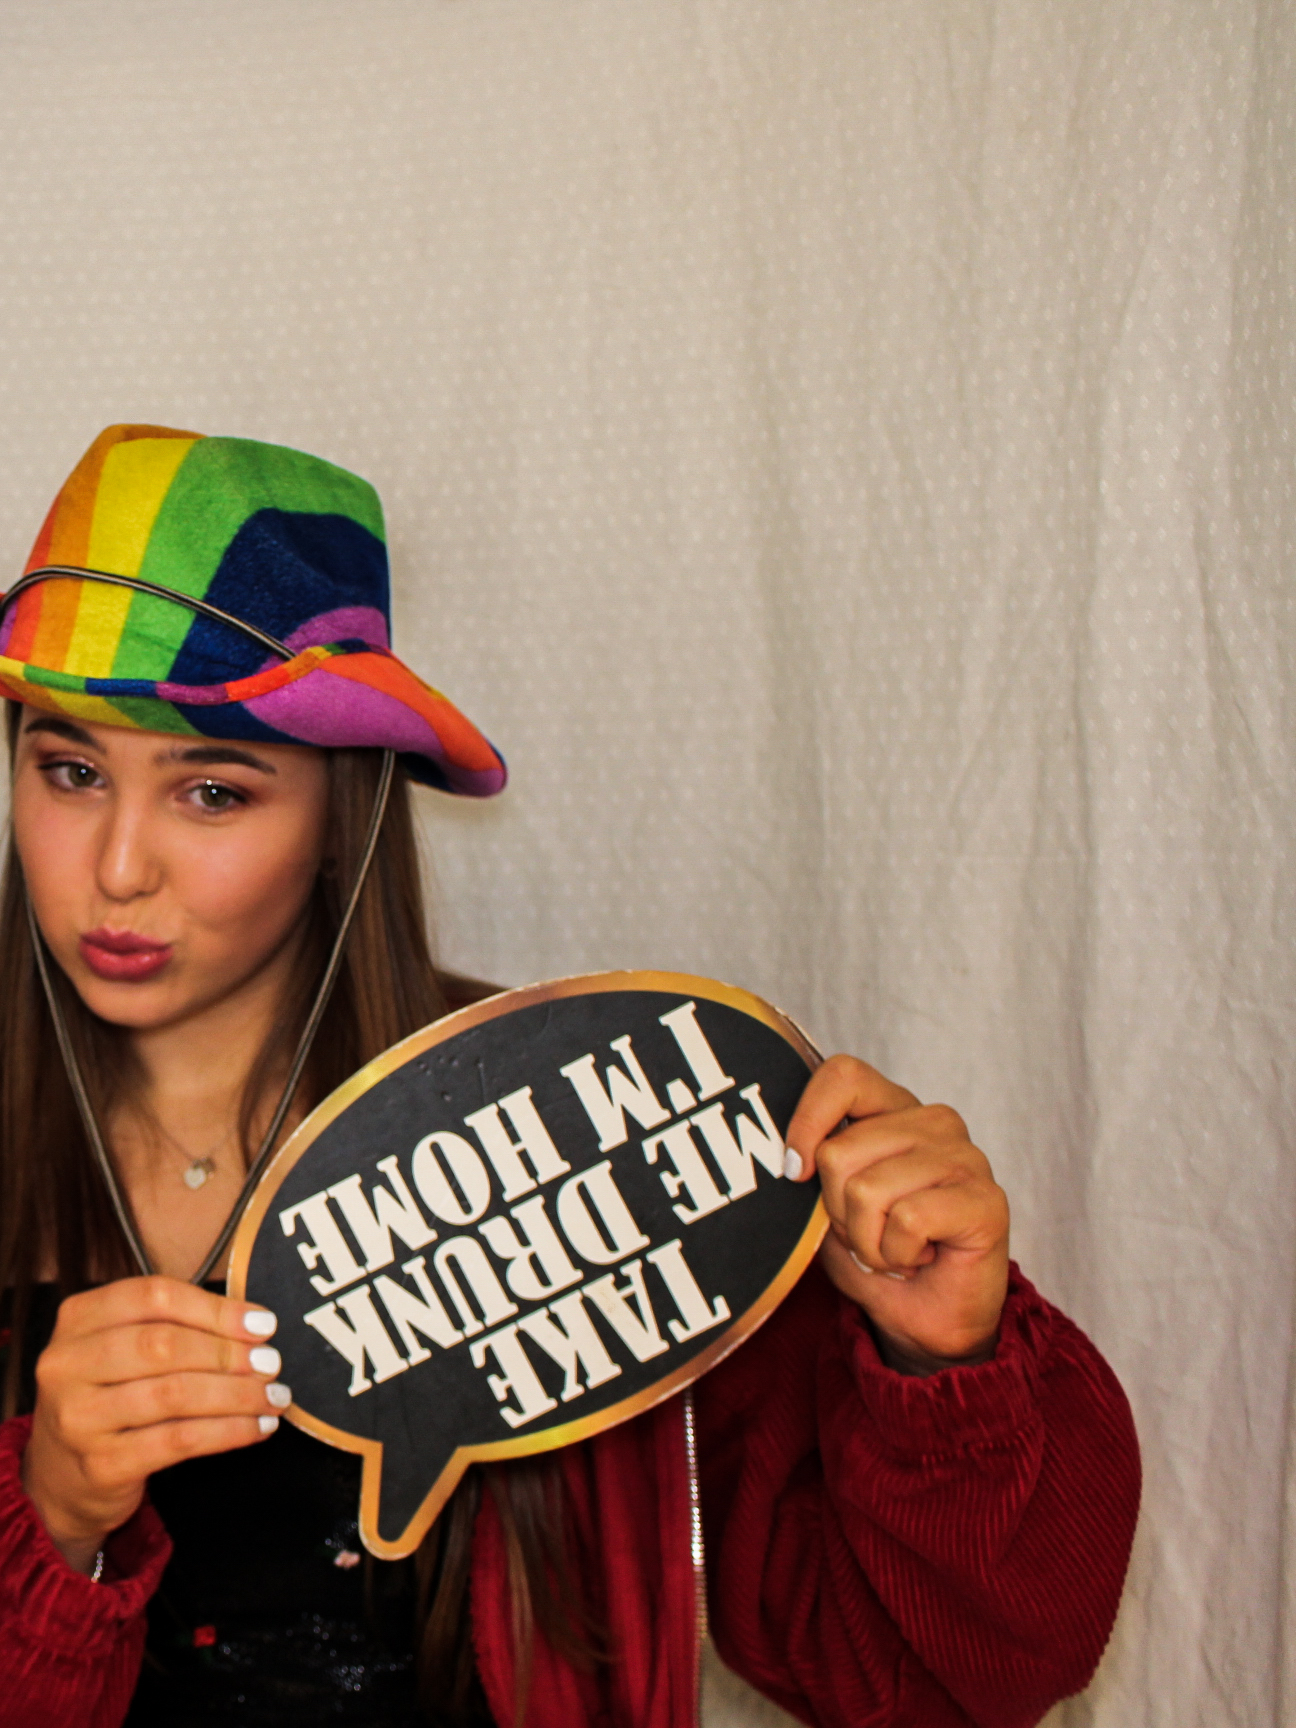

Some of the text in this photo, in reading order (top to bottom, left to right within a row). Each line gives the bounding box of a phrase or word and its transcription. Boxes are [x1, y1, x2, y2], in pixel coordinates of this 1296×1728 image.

[279, 1001, 735, 1297] I'M HOME
[304, 1083, 786, 1397] ME DRUNK
[469, 1239, 731, 1428] TAKE
